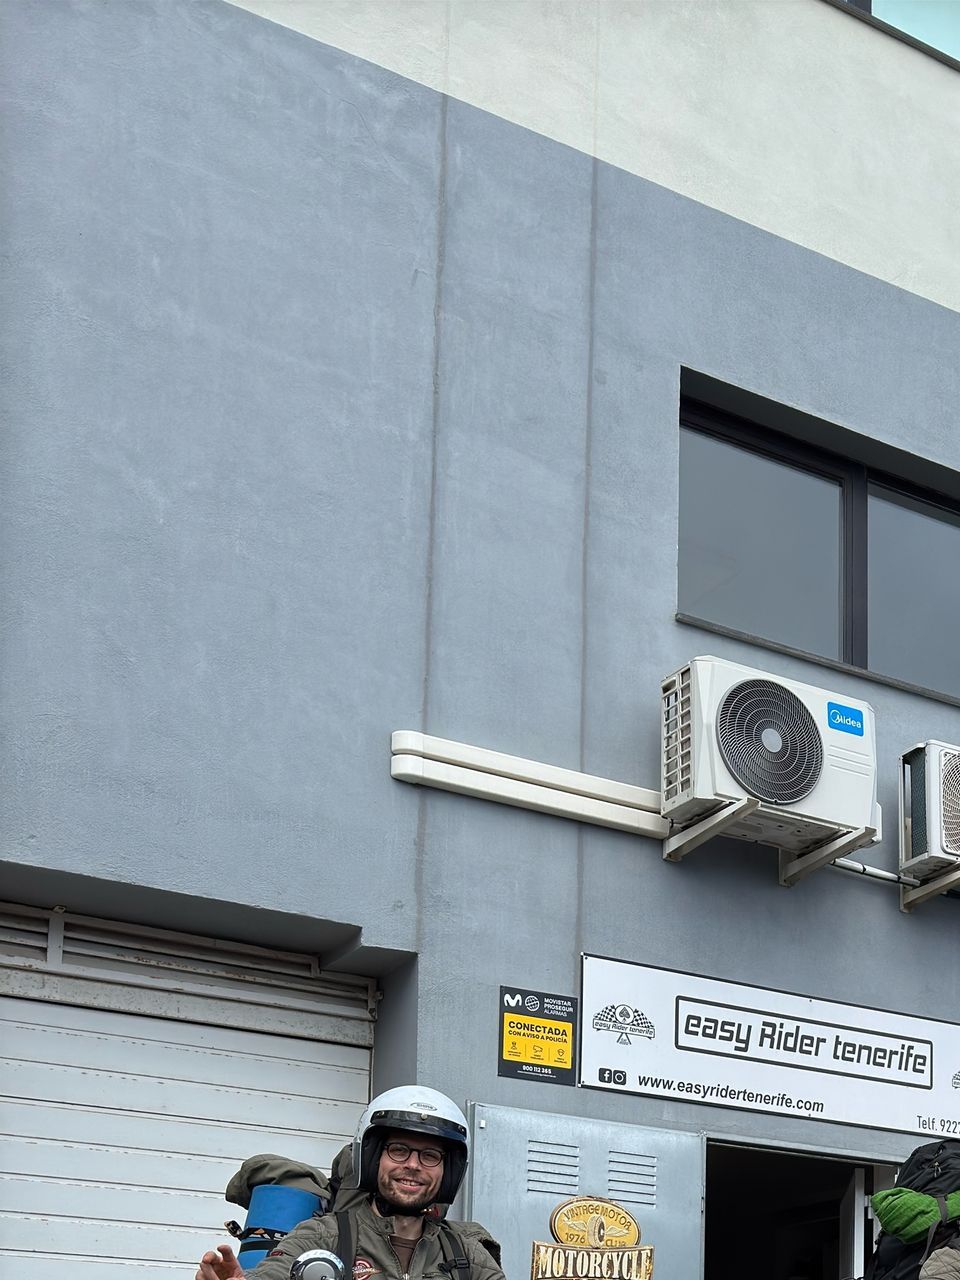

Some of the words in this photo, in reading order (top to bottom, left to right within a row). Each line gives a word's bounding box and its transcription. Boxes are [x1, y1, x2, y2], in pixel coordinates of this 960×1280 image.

[831, 709, 862, 728] Midea
[544, 998, 571, 1006] MOVISTAR
[544, 1003, 573, 1012] PROSEGUR
[508, 1021, 568, 1037] CONECTADA
[522, 1032, 540, 1040] AVISO
[684, 1014, 752, 1053] easy
[759, 1021, 826, 1057] Rider
[832, 1035, 927, 1074] tenerife
[638, 1075, 824, 1113] www.easyridertenerife.com
[917, 1115, 938, 1131] Telf.
[601, 1206, 631, 1231] MOTOR
[565, 1232, 585, 1244] 1976
